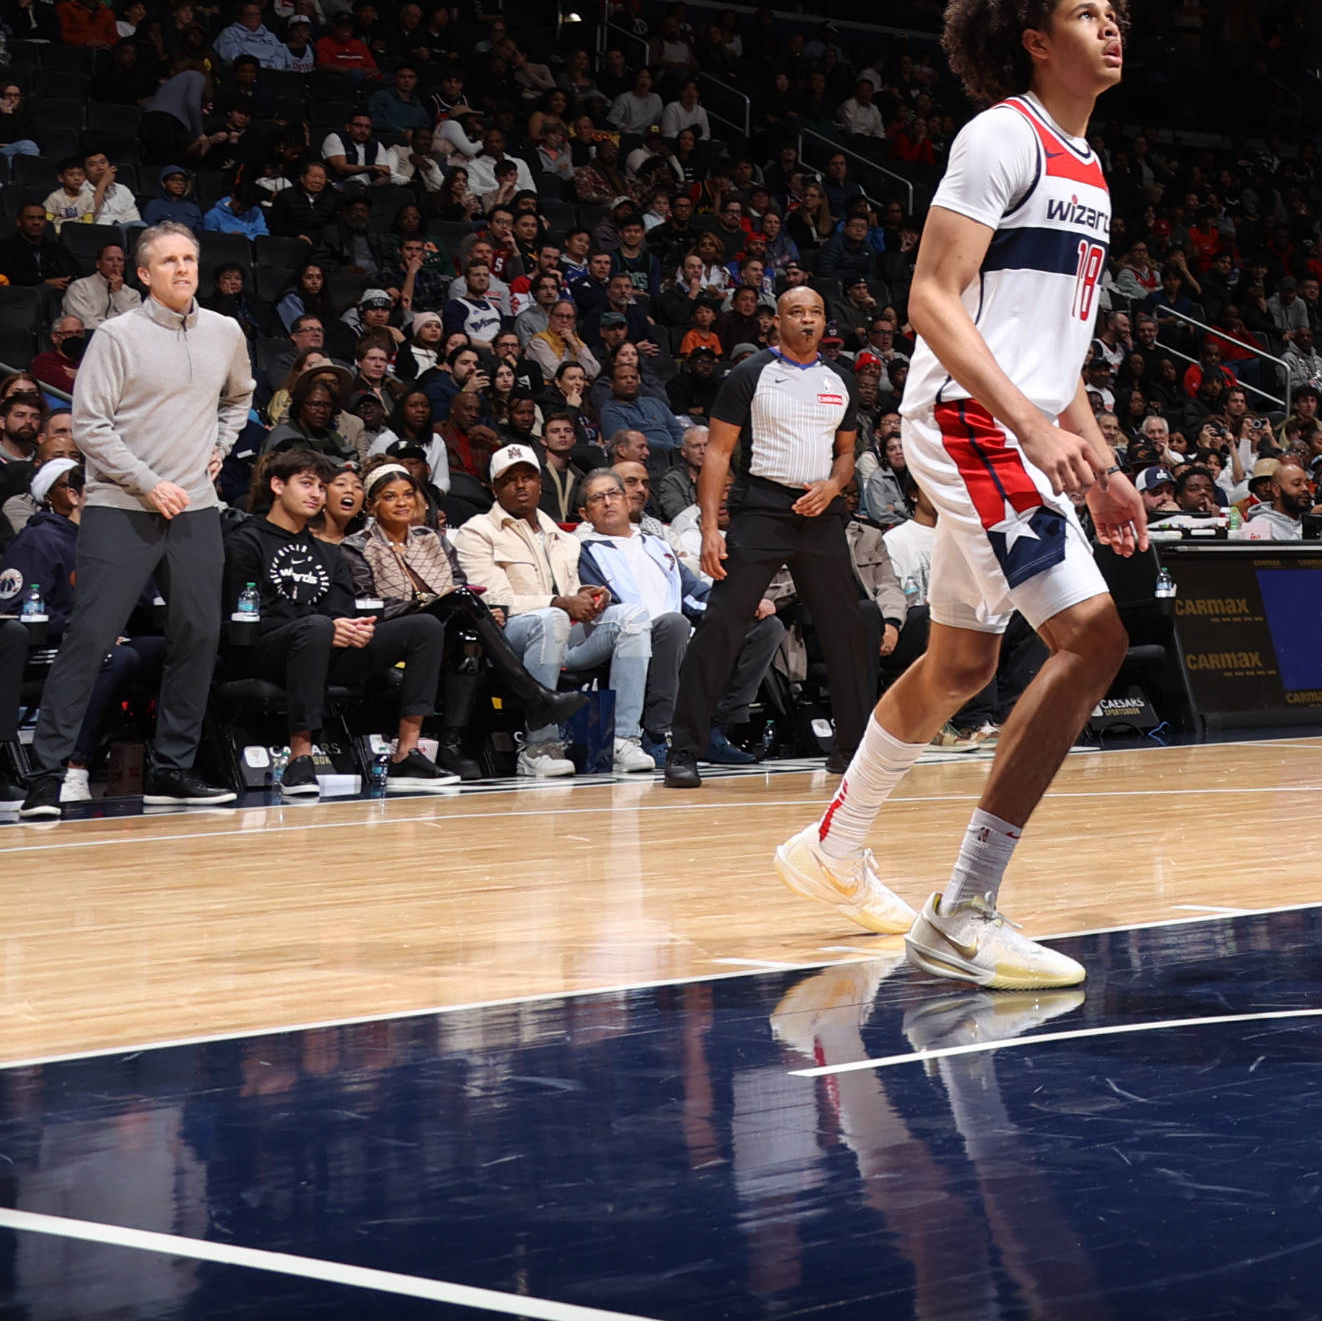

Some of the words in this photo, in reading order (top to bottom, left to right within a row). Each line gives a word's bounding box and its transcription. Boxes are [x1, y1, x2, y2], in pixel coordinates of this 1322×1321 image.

[1046, 194, 1109, 235] wizar
[1071, 239, 1105, 322] 18
[269, 742, 342, 758] CAARS
